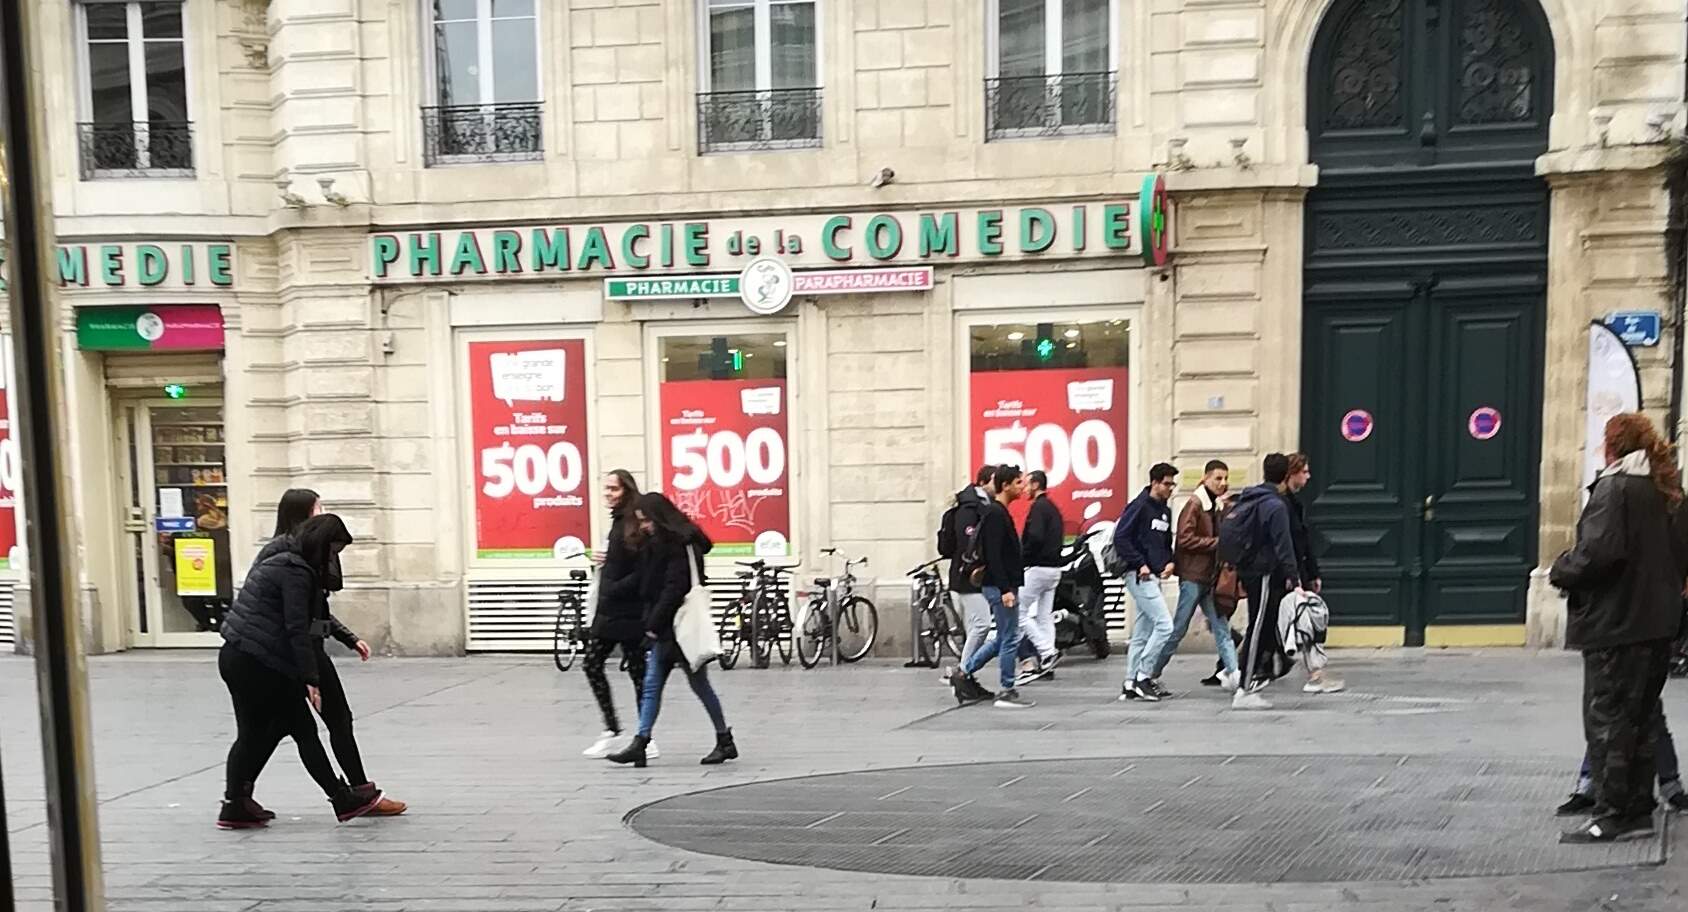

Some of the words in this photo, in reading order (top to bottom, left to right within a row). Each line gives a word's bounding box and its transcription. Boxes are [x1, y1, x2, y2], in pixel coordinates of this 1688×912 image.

[373, 222, 711, 277] PHARMACIE
[726, 229, 761, 256] de
[774, 229, 802, 254] la
[820, 202, 1132, 261] COMEDIE
[0, 243, 234, 288] MEDIE
[795, 271, 924, 290] PARAPHARMACIE
[625, 279, 731, 295] PHARMACIE
[493, 426, 510, 436] en
[510, 424, 546, 435] baisse
[547, 425, 567, 435] sur
[512, 412, 548, 424] Tarifs
[481, 441, 583, 498] 500
[671, 427, 785, 491] 500
[983, 419, 1117, 488] 500
[532, 495, 583, 509] produits
